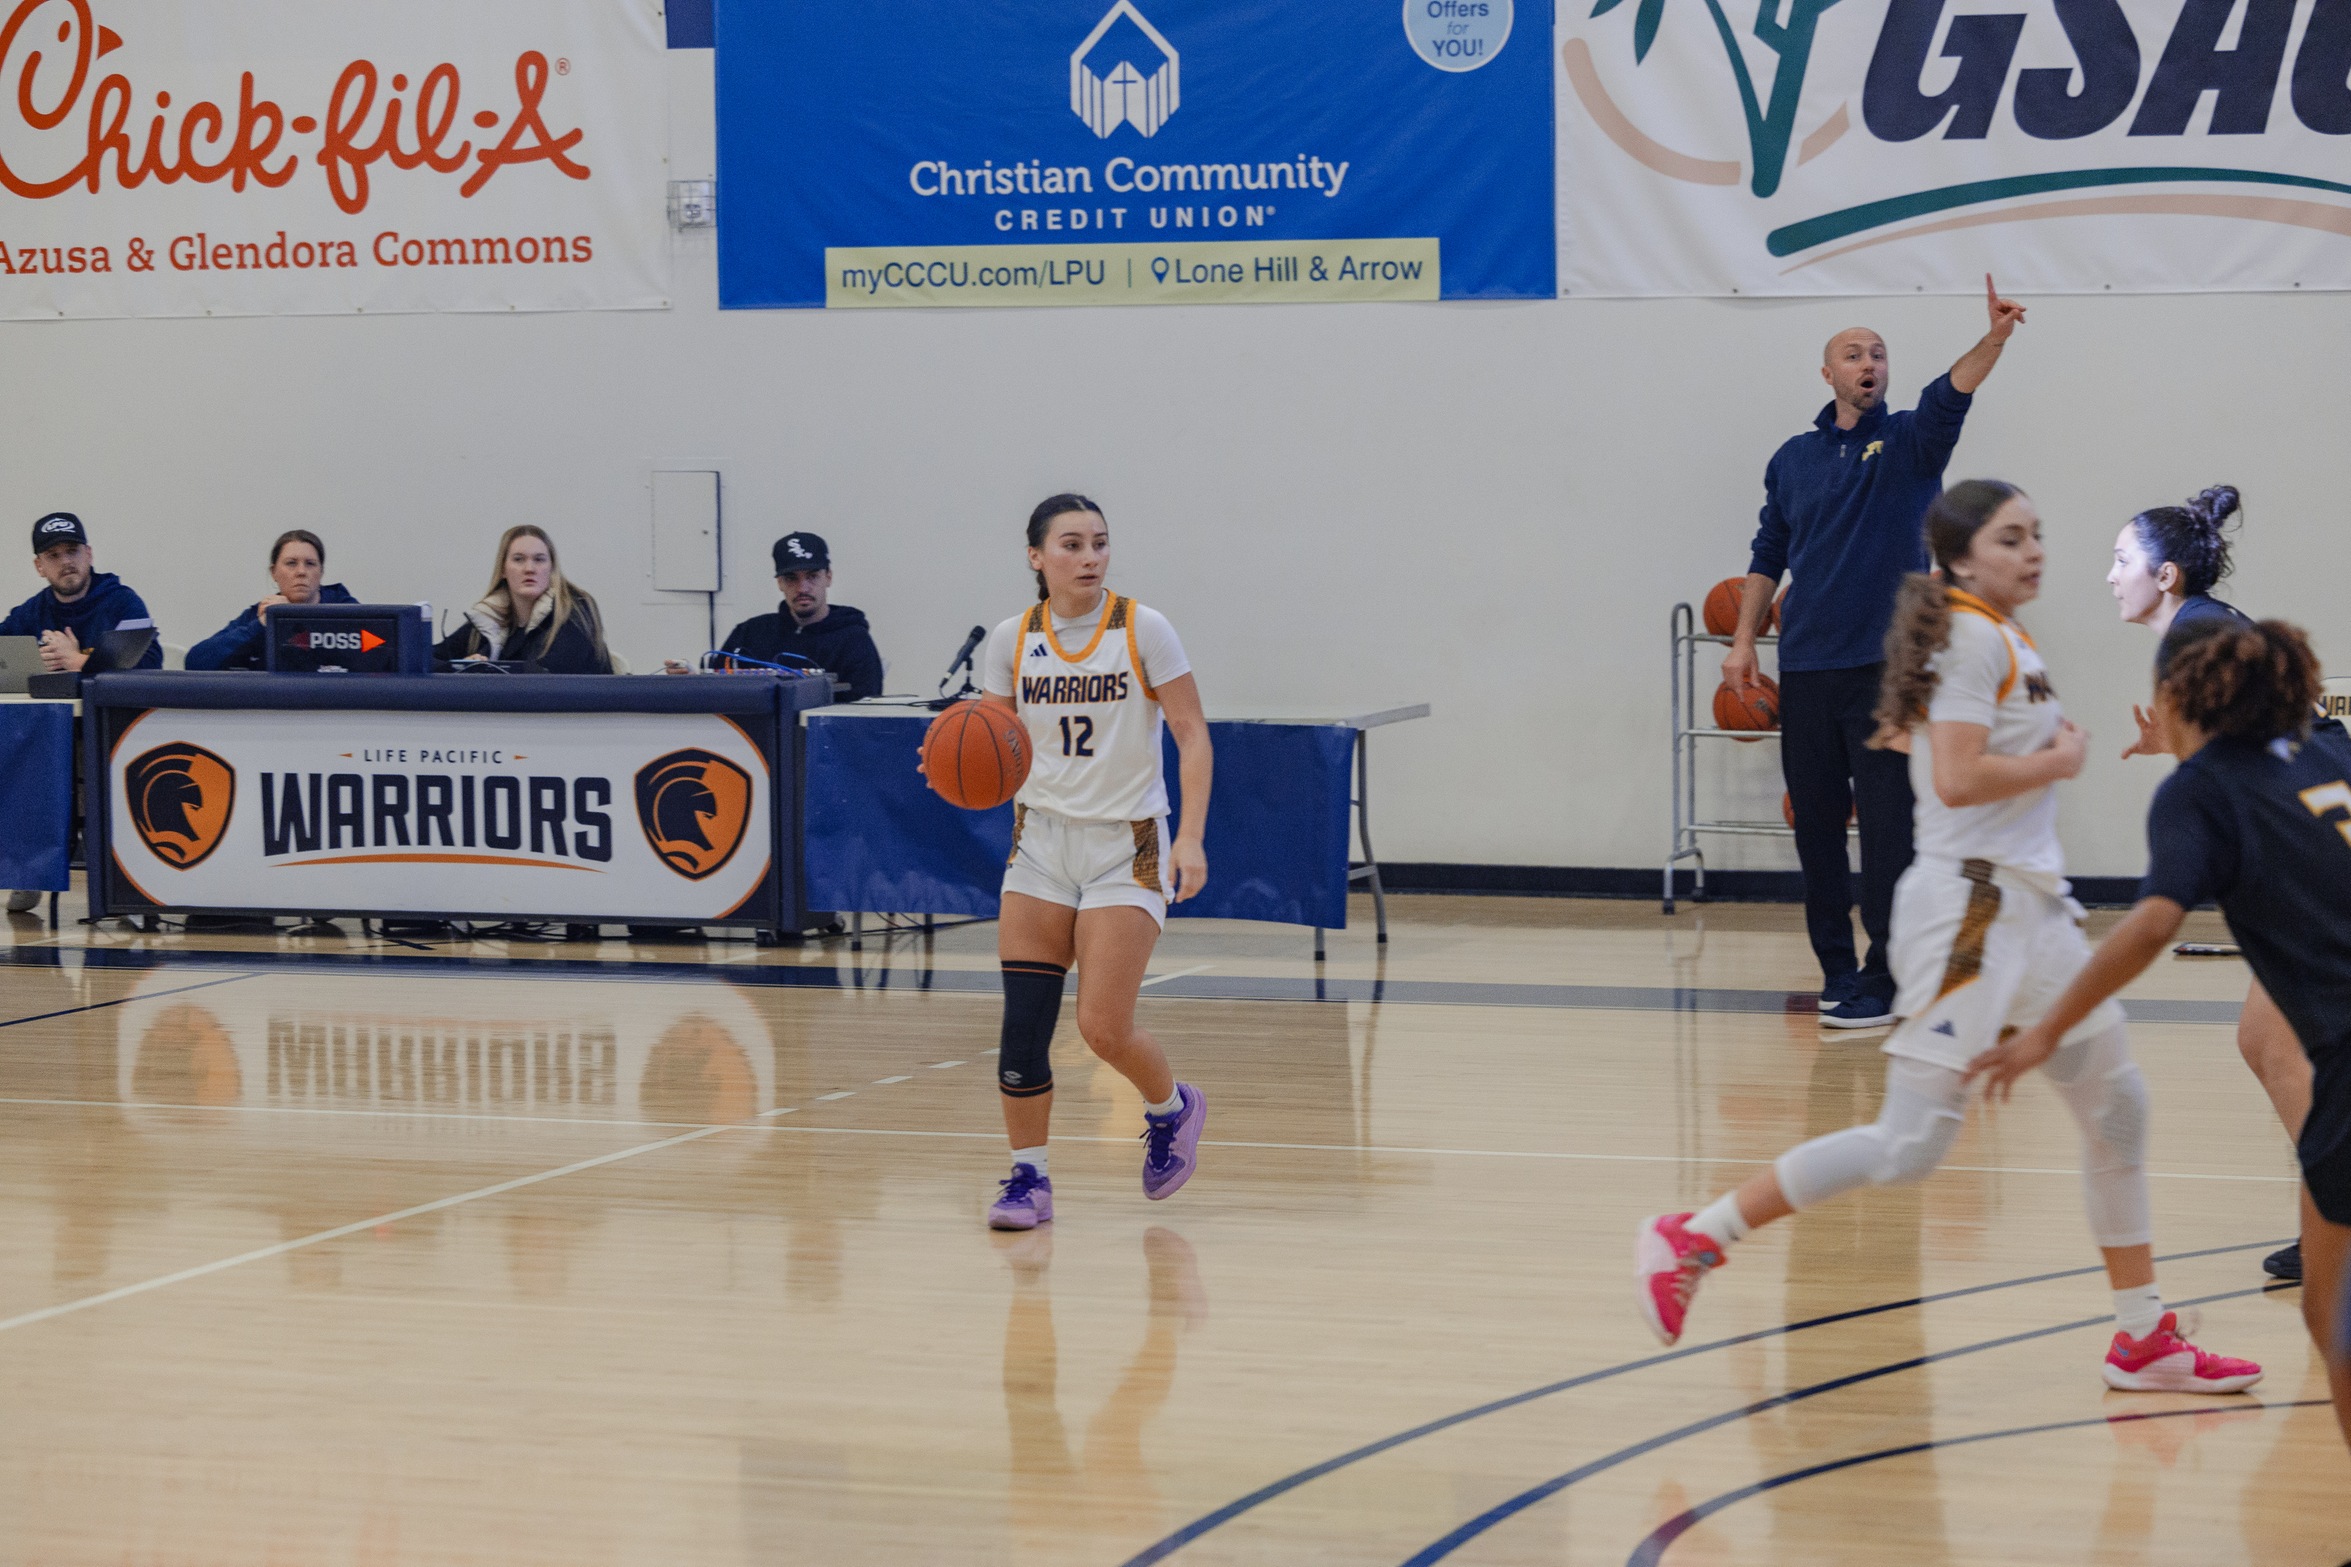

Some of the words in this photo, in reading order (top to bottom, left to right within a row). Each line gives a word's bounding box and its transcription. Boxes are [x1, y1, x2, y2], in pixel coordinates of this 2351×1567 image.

[1427, 0, 1489, 18] Offers
[1446, 21, 1470, 36] for
[1432, 38, 1484, 57] YOU!
[909, 159, 1093, 196] Christian
[1105, 153, 1349, 198] Community
[994, 207, 1127, 231] CREDIT
[0, 240, 112, 275] Azusa
[126, 236, 155, 272] &
[169, 231, 358, 272] Glendora
[373, 231, 593, 267] Commons
[842, 259, 1105, 294] myCCCU.com/LPU
[1175, 258, 1244, 284] Lone
[1254, 256, 1298, 282] Hill
[1309, 255, 1329, 282] &
[1338, 255, 1423, 282] Arrow
[310, 632, 361, 650] POSS
[1022, 670, 1129, 705] WARRIORS
[1059, 715, 1094, 757] 12
[364, 749, 408, 763] LIFE
[420, 750, 503, 764] PACIFIC
[260, 772, 612, 863] WARRIORS
